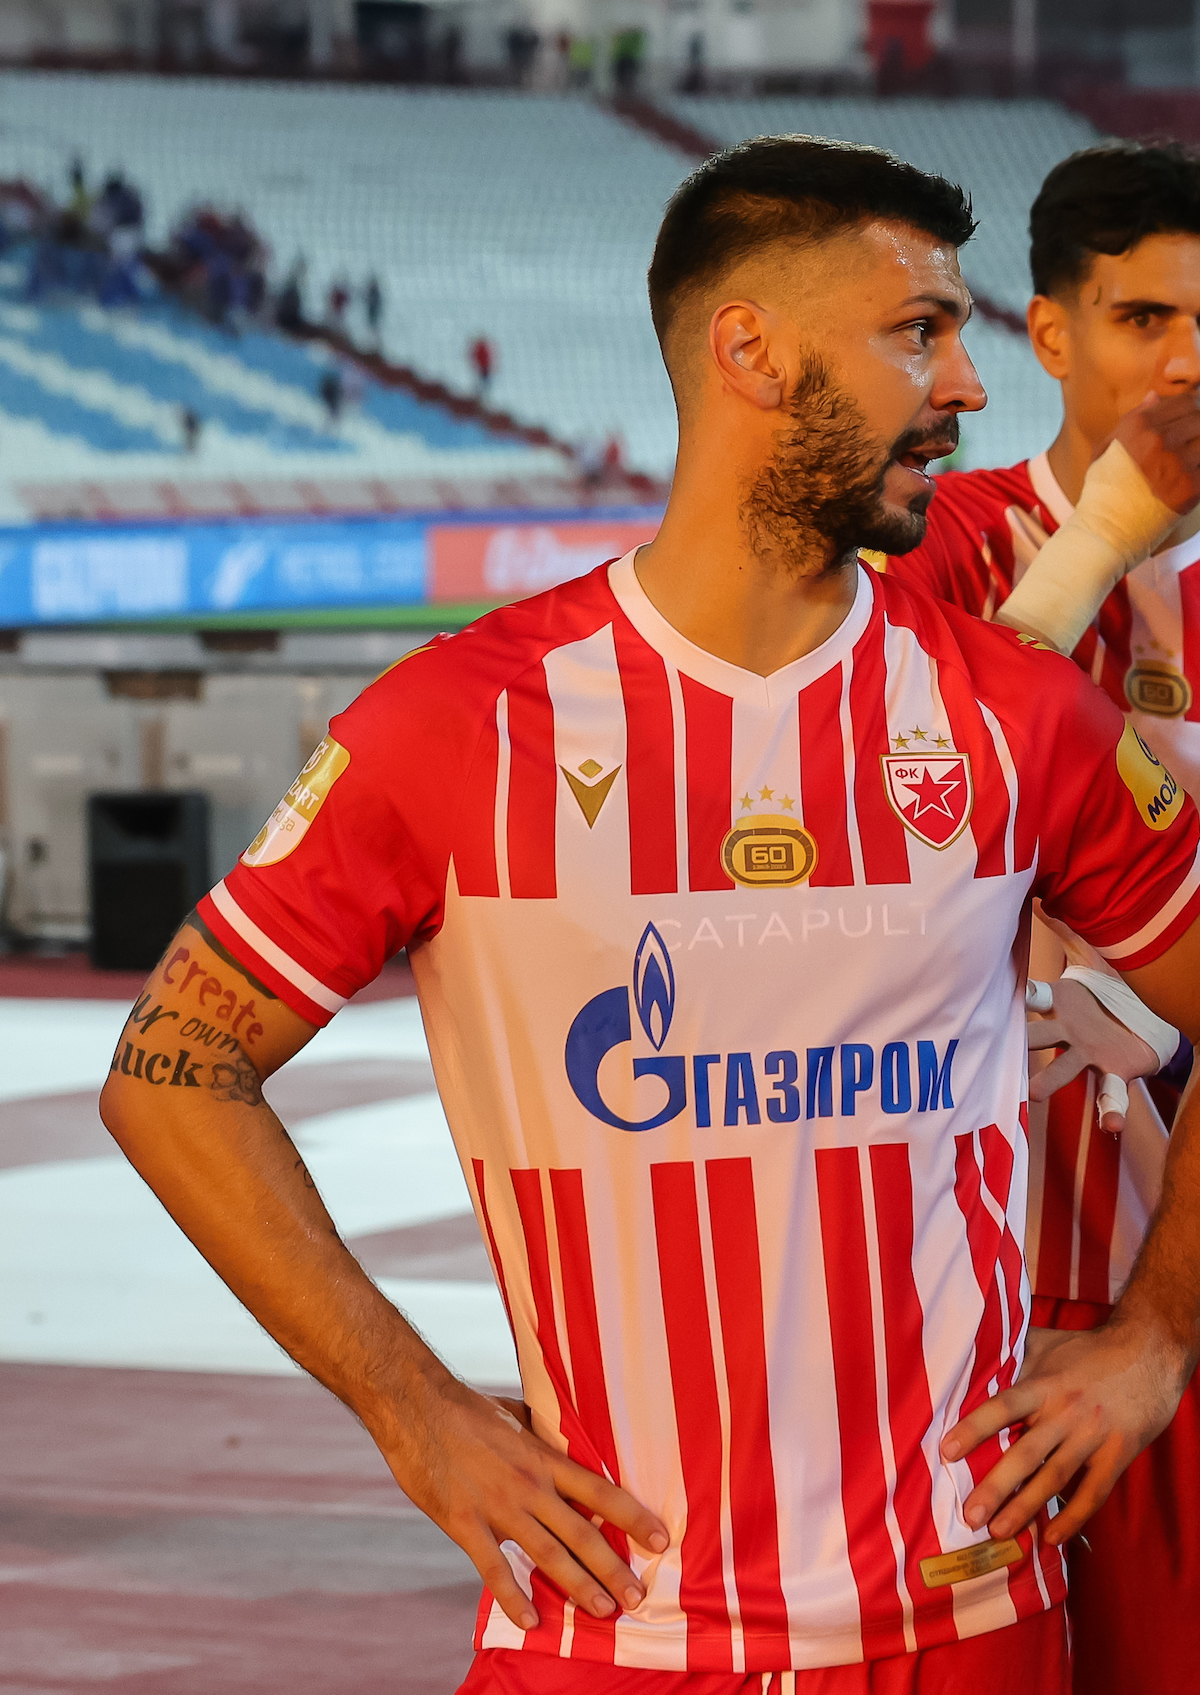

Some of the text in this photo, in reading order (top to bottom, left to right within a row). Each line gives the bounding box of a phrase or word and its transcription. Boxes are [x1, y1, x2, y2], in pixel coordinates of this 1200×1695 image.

[894, 767, 920, 780] ФК
[1147, 770, 1178, 823] MOZ
[751, 846, 787, 865] 60
[648, 901, 929, 954] CATAPULT
[163, 946, 264, 1045] create
[179, 1017, 240, 1054] own
[693, 1038, 960, 1128] ГАЗПРОМ
